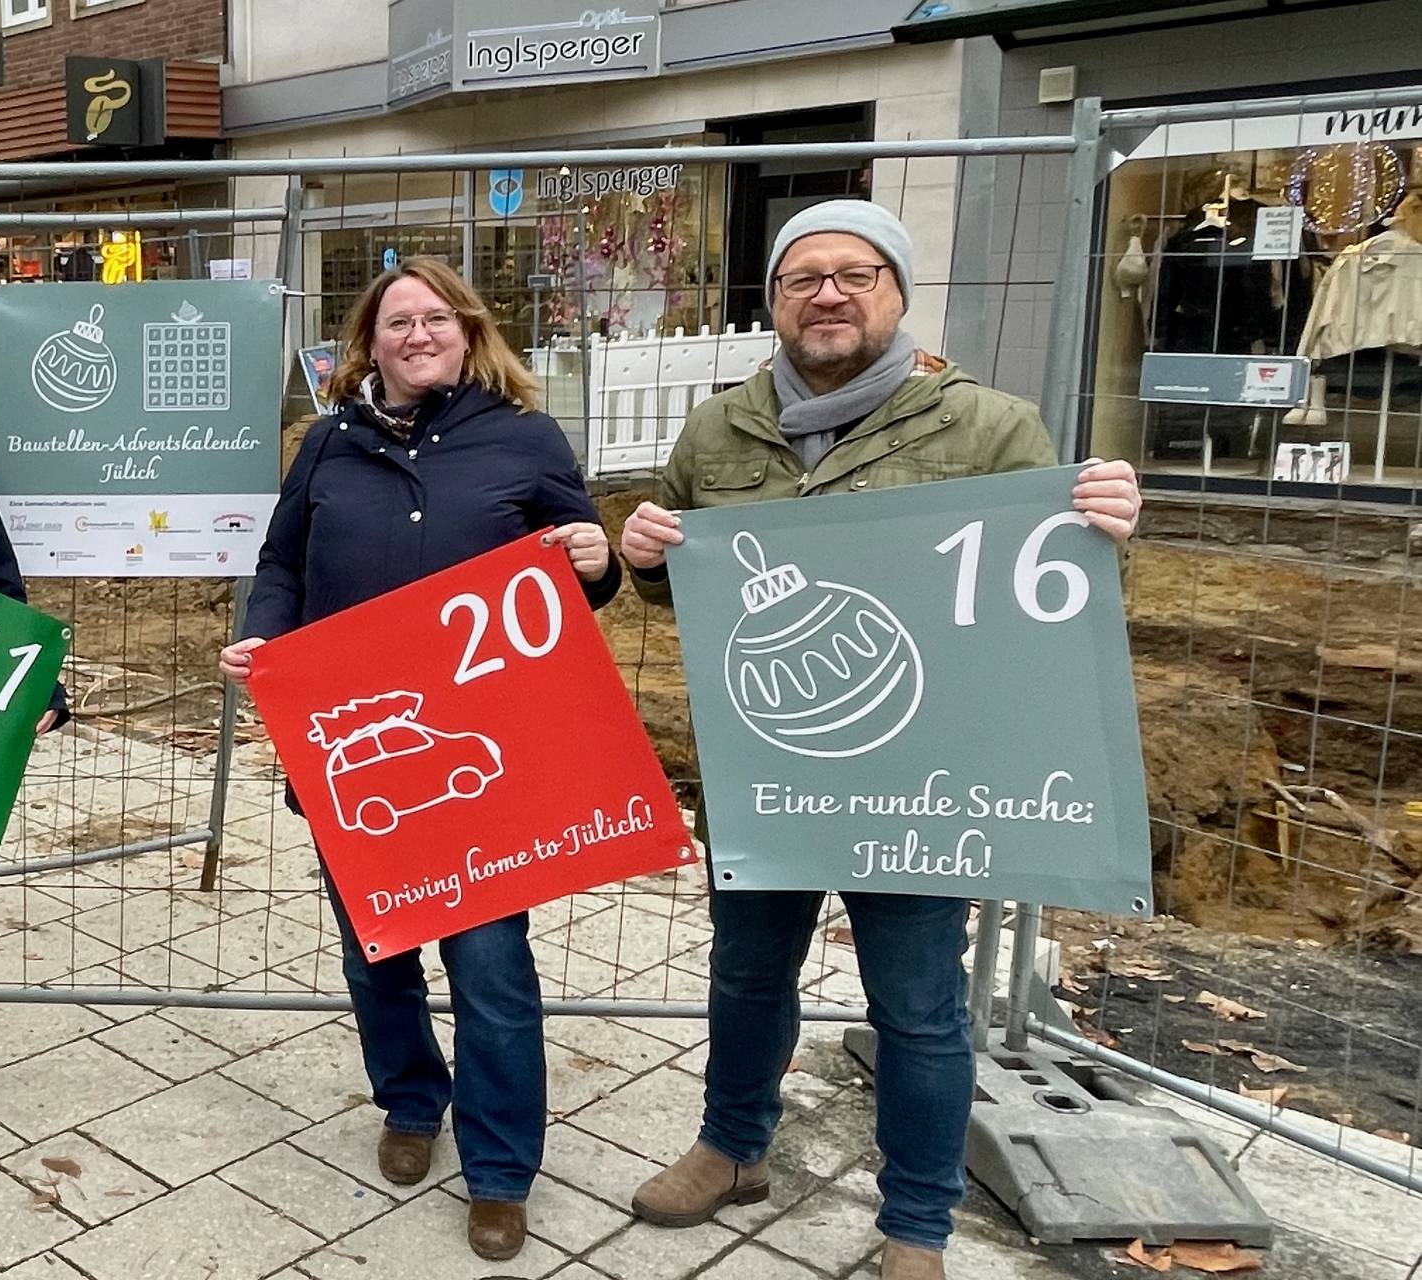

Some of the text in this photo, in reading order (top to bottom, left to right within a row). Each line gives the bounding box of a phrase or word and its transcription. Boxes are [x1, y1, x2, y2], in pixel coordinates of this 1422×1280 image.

[468, 33, 643, 73] Inglsperger
[537, 164, 683, 203] Inglsperger
[8, 425, 260, 452] Baustellen-Adventskalender
[99, 455, 163, 483] Jülich
[934, 510, 1091, 627] 16
[440, 566, 563, 686] 20
[751, 783, 842, 815] Eine
[848, 769, 962, 817] runde
[367, 794, 654, 916] Driving home to Jülich!
[851, 828, 993, 879] Jülich!
